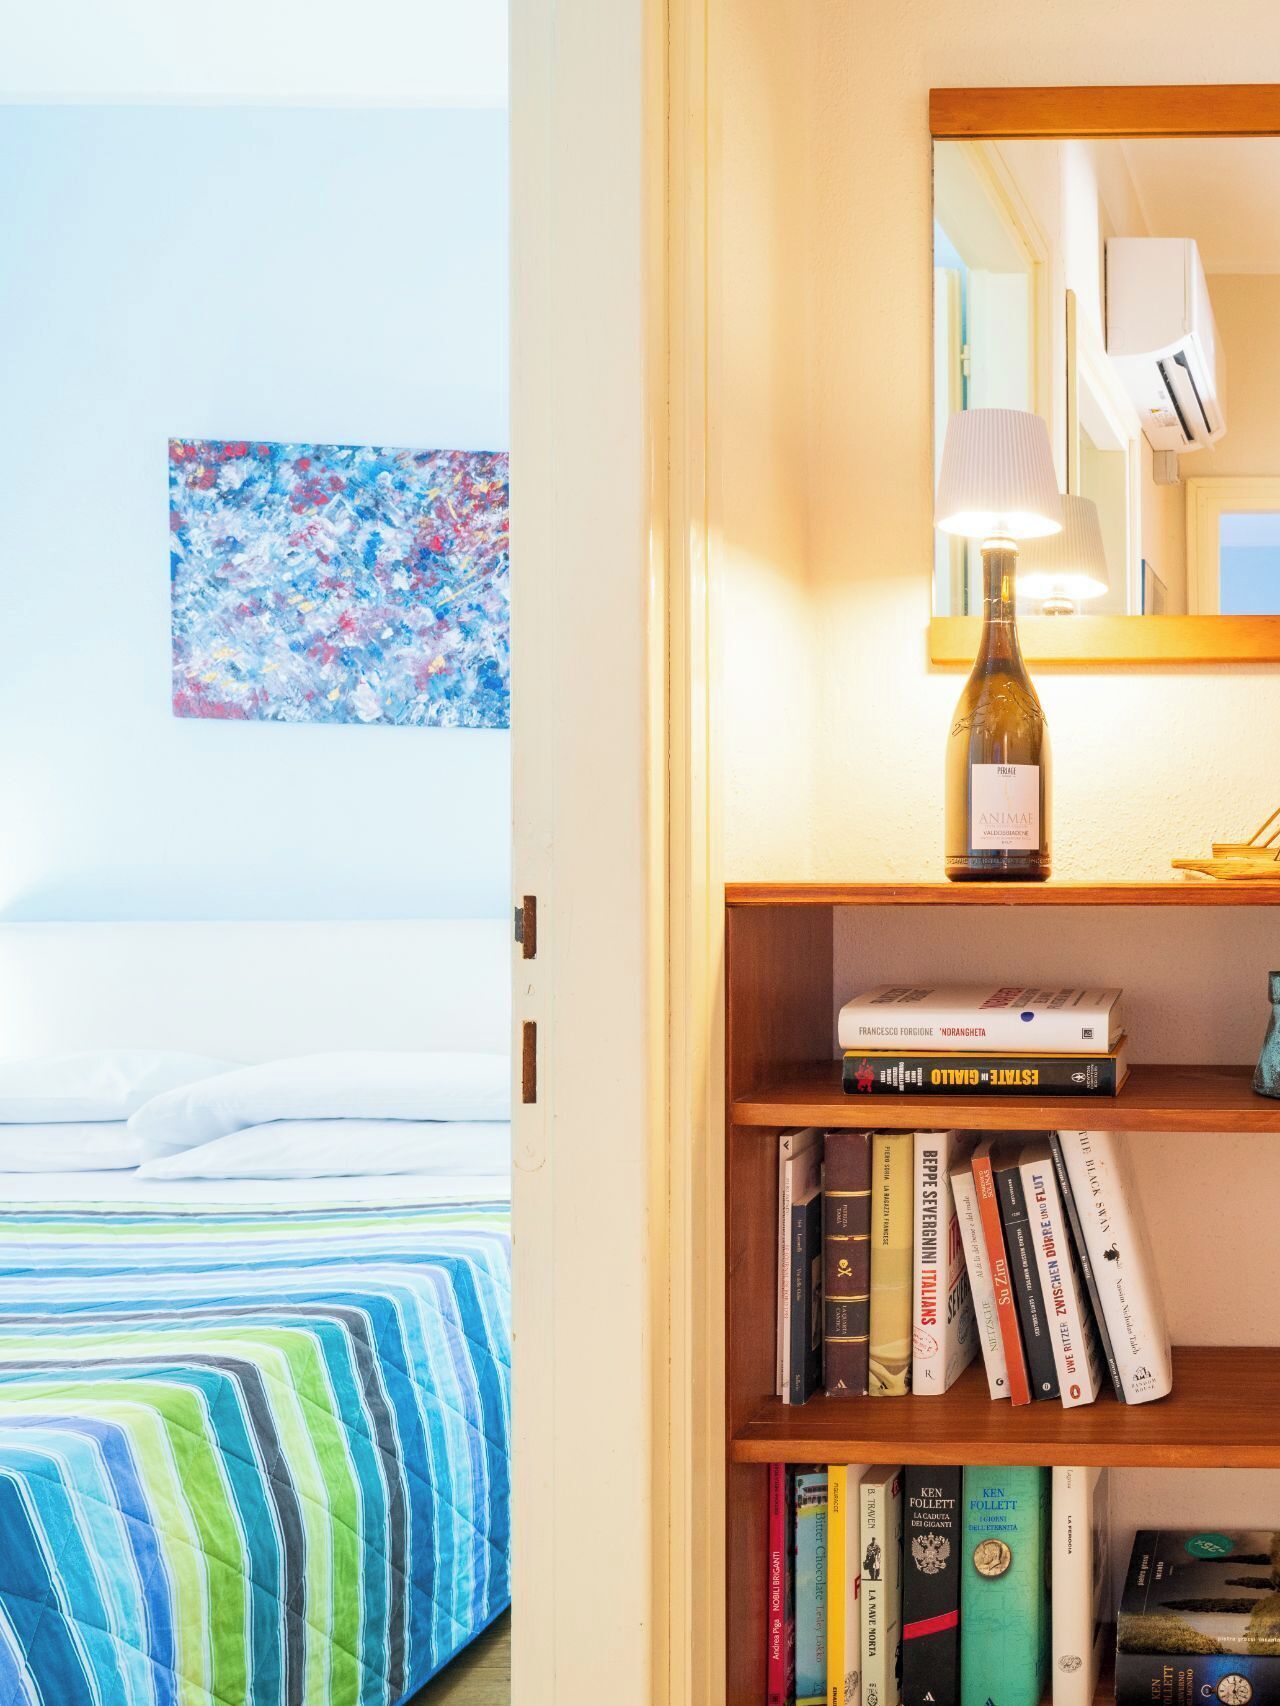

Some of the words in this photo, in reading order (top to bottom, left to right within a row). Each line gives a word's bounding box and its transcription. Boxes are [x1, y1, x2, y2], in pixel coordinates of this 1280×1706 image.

[979, 811, 1034, 824] ANIMAE
[858, 1025, 899, 1037] FRANCESCO
[899, 1026, 934, 1037] FORGIONE
[931, 1067, 980, 1086] GIALLO
[981, 1072, 989, 1081] IN
[989, 1068, 1039, 1086] ESTATE
[922, 1150, 938, 1187] BEPPE
[883, 1185, 890, 1193] LA
[978, 1170, 988, 1200] DOMENICO
[983, 1170, 994, 1199] SOLINAS
[1032, 1174, 1047, 1203] FLUT
[1078, 1130, 1092, 1154] THE
[1085, 1159, 1102, 1196] BLACK
[1095, 1202, 1111, 1233] SWAN
[963, 1195, 972, 1210] male
[1038, 1203, 1050, 1220] UND
[921, 1190, 938, 1265] SEVERGNINI
[966, 1212, 974, 1222] del
[1017, 1228, 1026, 1248] VALERIO
[1040, 1220, 1057, 1258] DÜRRE
[994, 1258, 1007, 1287] Ziru
[921, 1269, 938, 1326] ITALIANS
[998, 1288, 1011, 1306] Su
[1047, 1260, 1068, 1317] ZWISCHEN
[982, 1300, 999, 1352] NIETZSCHE
[1116, 1278, 1126, 1303] Nassim
[1121, 1305, 1133, 1334] Nicholas
[1129, 1335, 1140, 1355] Taleb
[1059, 1322, 1073, 1353] RITZER
[1065, 1354, 1077, 1374] UWE
[867, 1488, 876, 1497] B.
[909, 1497, 956, 1509] FOLLETT
[921, 1487, 943, 1498] KEN
[970, 1499, 1018, 1510] FOLLETT
[983, 1487, 1005, 1498] KEN
[867, 1499, 876, 1529] TRAVEN
[911, 1520, 922, 1528] DEI
[923, 1520, 953, 1528] GIGANTI
[913, 1512, 922, 1520] LA
[922, 1512, 951, 1520] CADUTA
[983, 1515, 1008, 1523] GIORNI
[815, 1511, 827, 1543] Bitter
[772, 1551, 781, 1586] BRIGANTI
[815, 1545, 827, 1600] Chocolate
[772, 1586, 780, 1612] NOBILI
[868, 1589, 876, 1601] LA
[814, 1605, 825, 1632] Lesley
[868, 1603, 877, 1626] NAVE
[772, 1635, 780, 1660] Andrea
[815, 1634, 825, 1663] Lokko
[868, 1628, 877, 1657] MORTA
[1151, 1679, 1161, 1700] KEN
[1162, 1664, 1173, 1706] OLLETT
